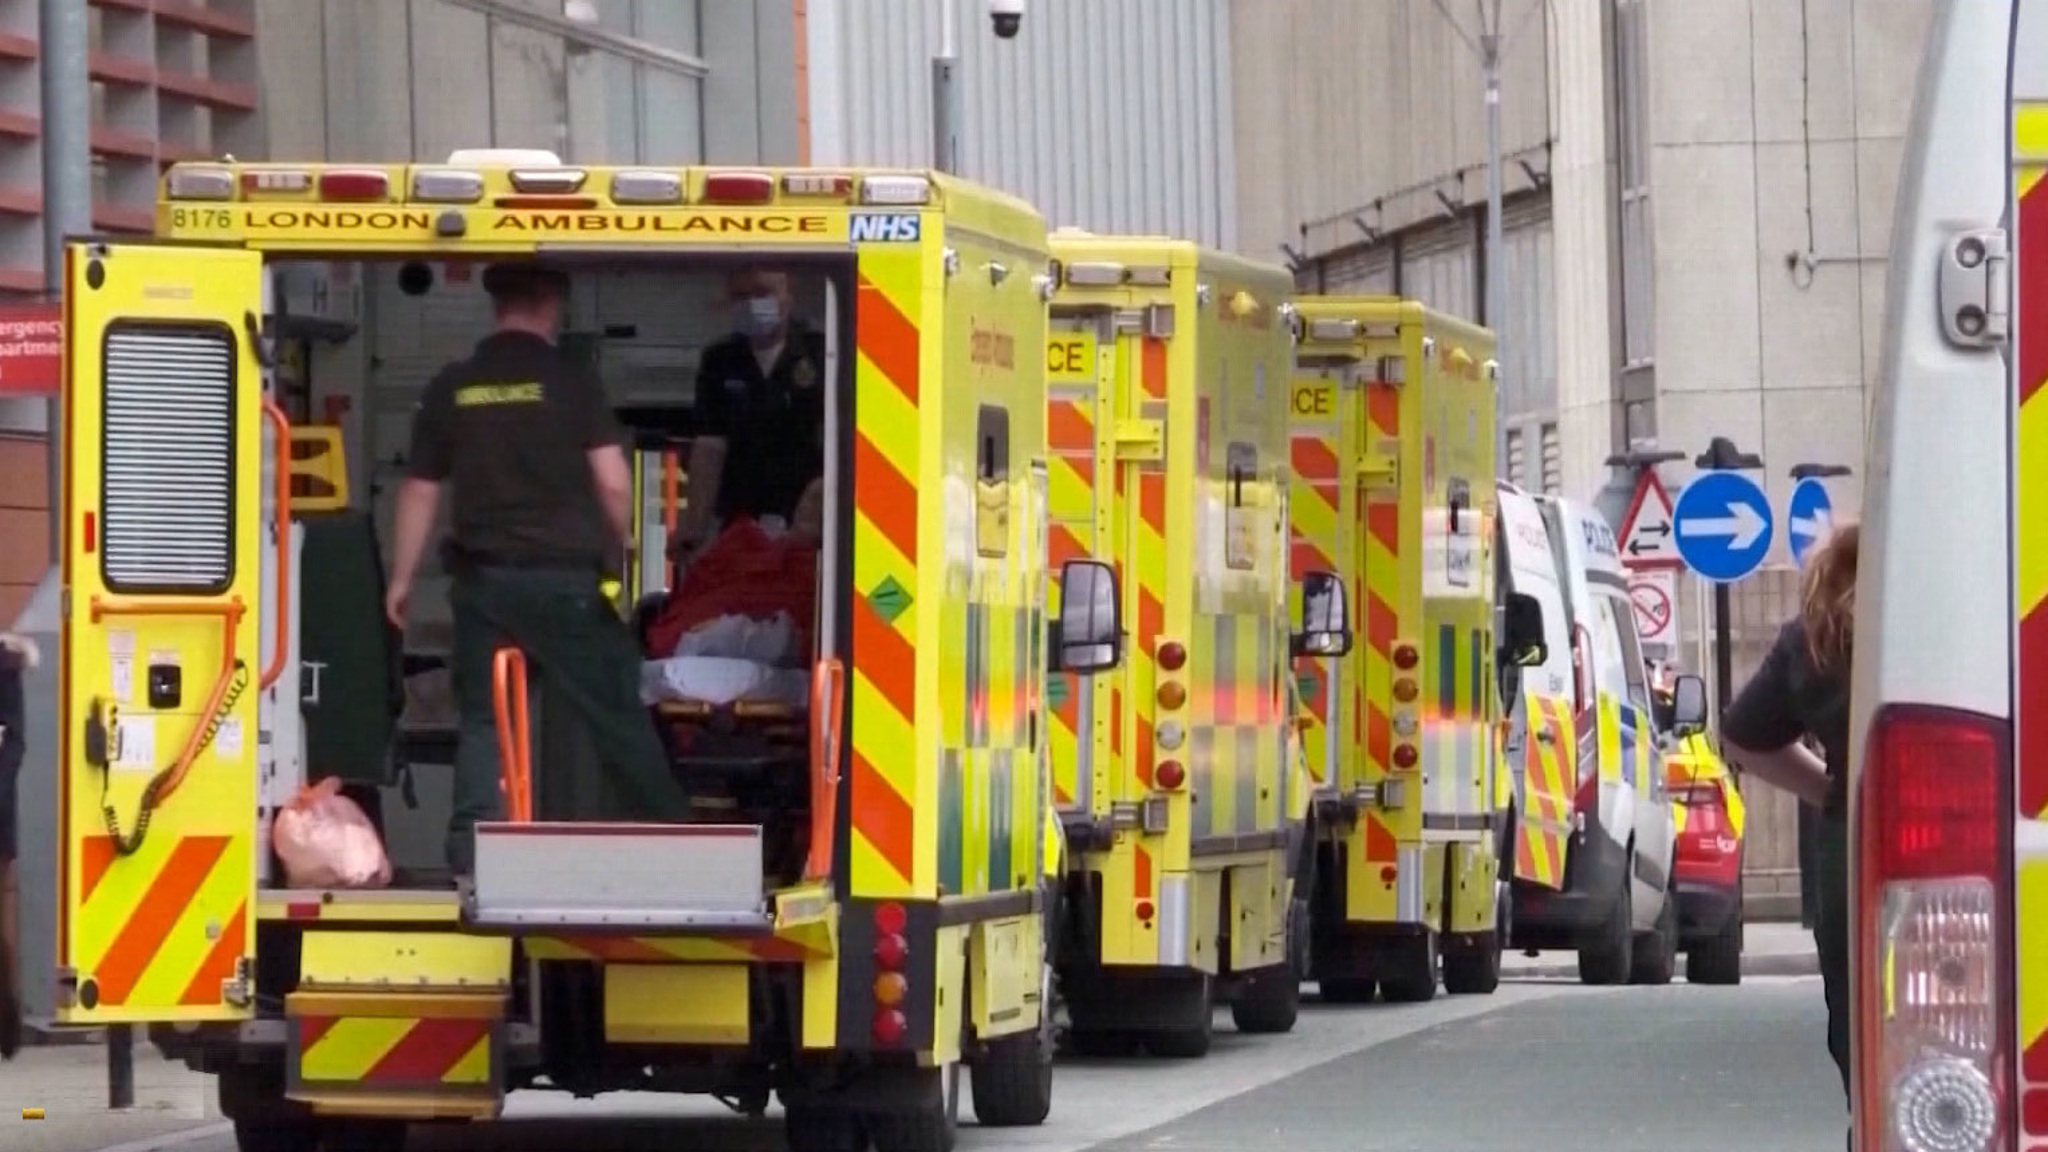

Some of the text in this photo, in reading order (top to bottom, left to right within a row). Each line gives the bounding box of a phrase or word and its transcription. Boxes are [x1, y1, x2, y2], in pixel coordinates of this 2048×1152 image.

[172, 209, 232, 229] 8176
[245, 211, 829, 233] LONDON AMBULANCE
[851, 214, 919, 241] NHS
[1048, 342, 1084, 372] CE
[1291, 387, 1331, 414] CE
